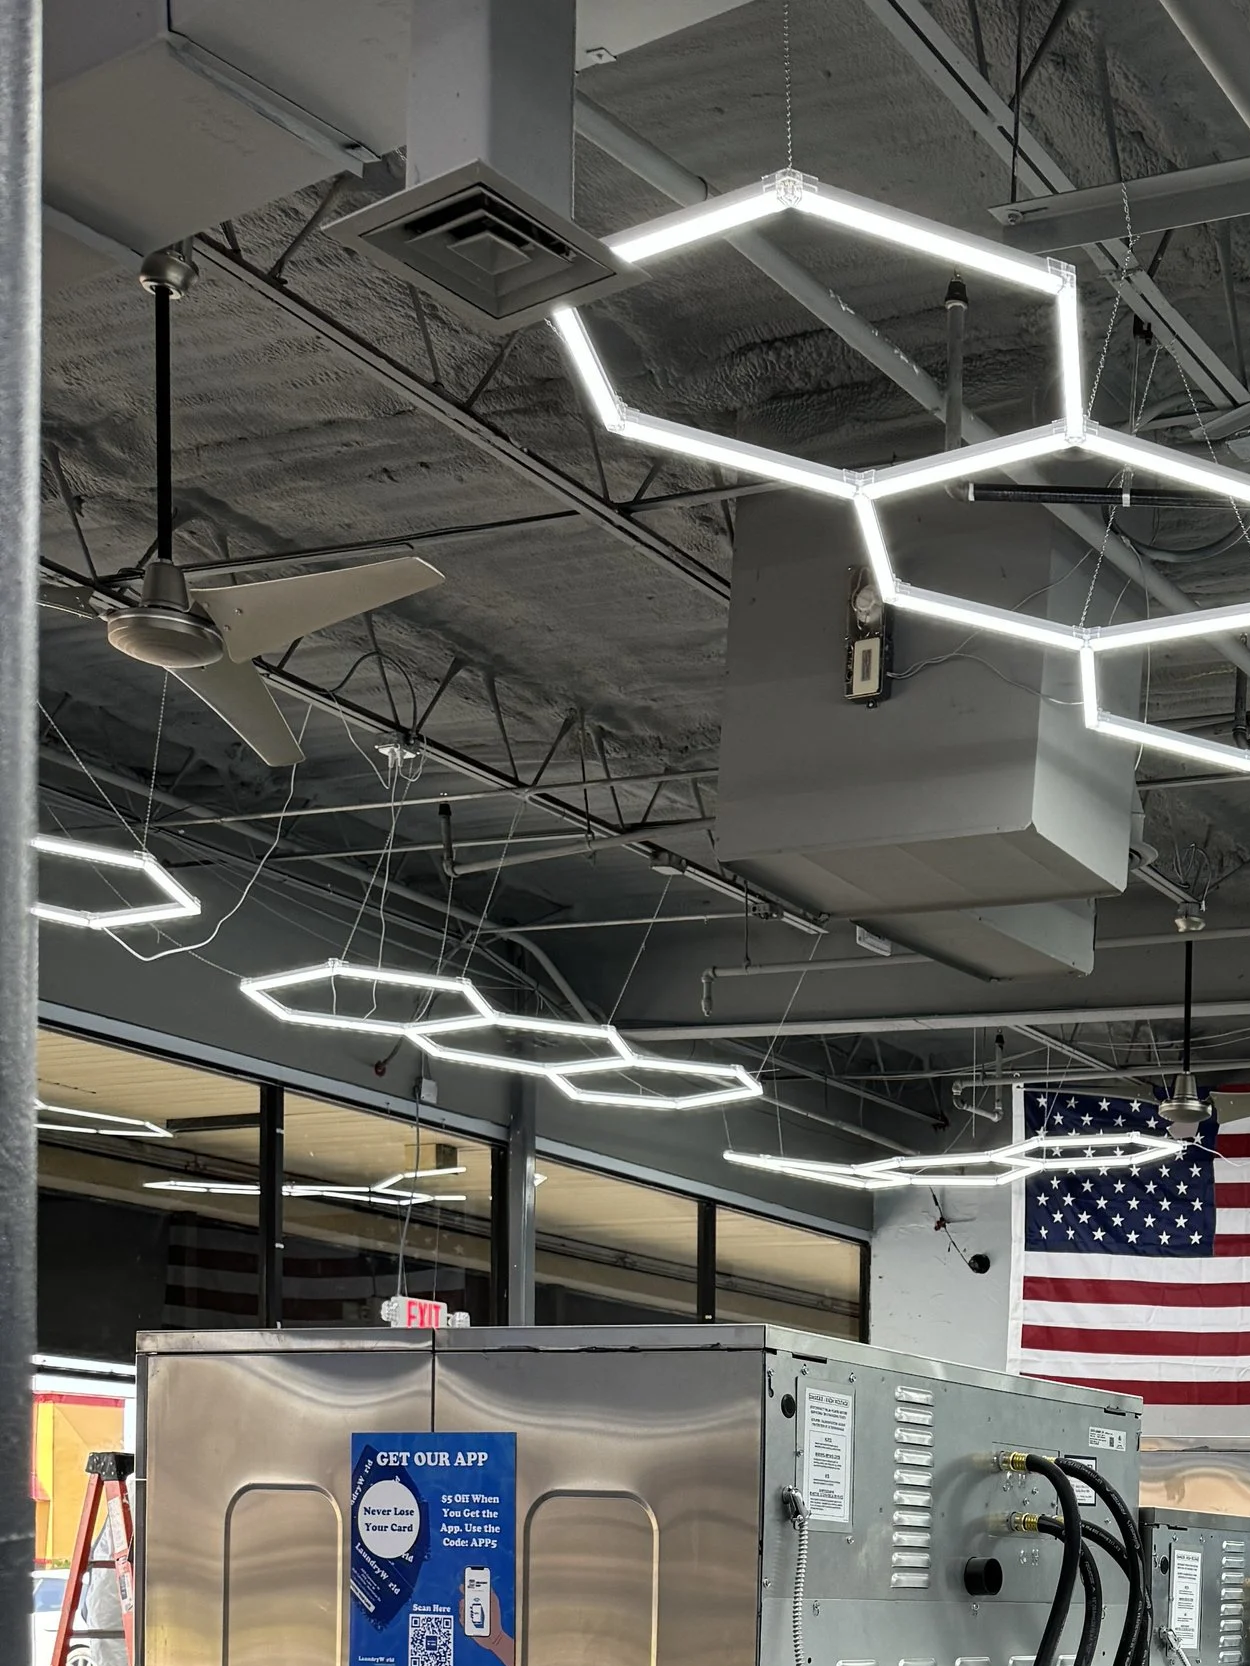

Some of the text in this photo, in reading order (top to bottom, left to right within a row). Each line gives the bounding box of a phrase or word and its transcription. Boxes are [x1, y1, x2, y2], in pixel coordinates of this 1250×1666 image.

[407, 1301, 441, 1328] EXIT
[376, 1452, 489, 1466] GET OUR APP
[441, 1493, 500, 1504] $5 Off When
[363, 1506, 415, 1516] Never Lose
[442, 1508, 499, 1518] You Get the
[365, 1523, 414, 1532] Your Card
[440, 1522, 501, 1534] App. Use the
[442, 1537, 498, 1549] Code: APP5
[355, 1542, 401, 1595] LaundryWrld
[412, 1604, 451, 1613] Scan Here
